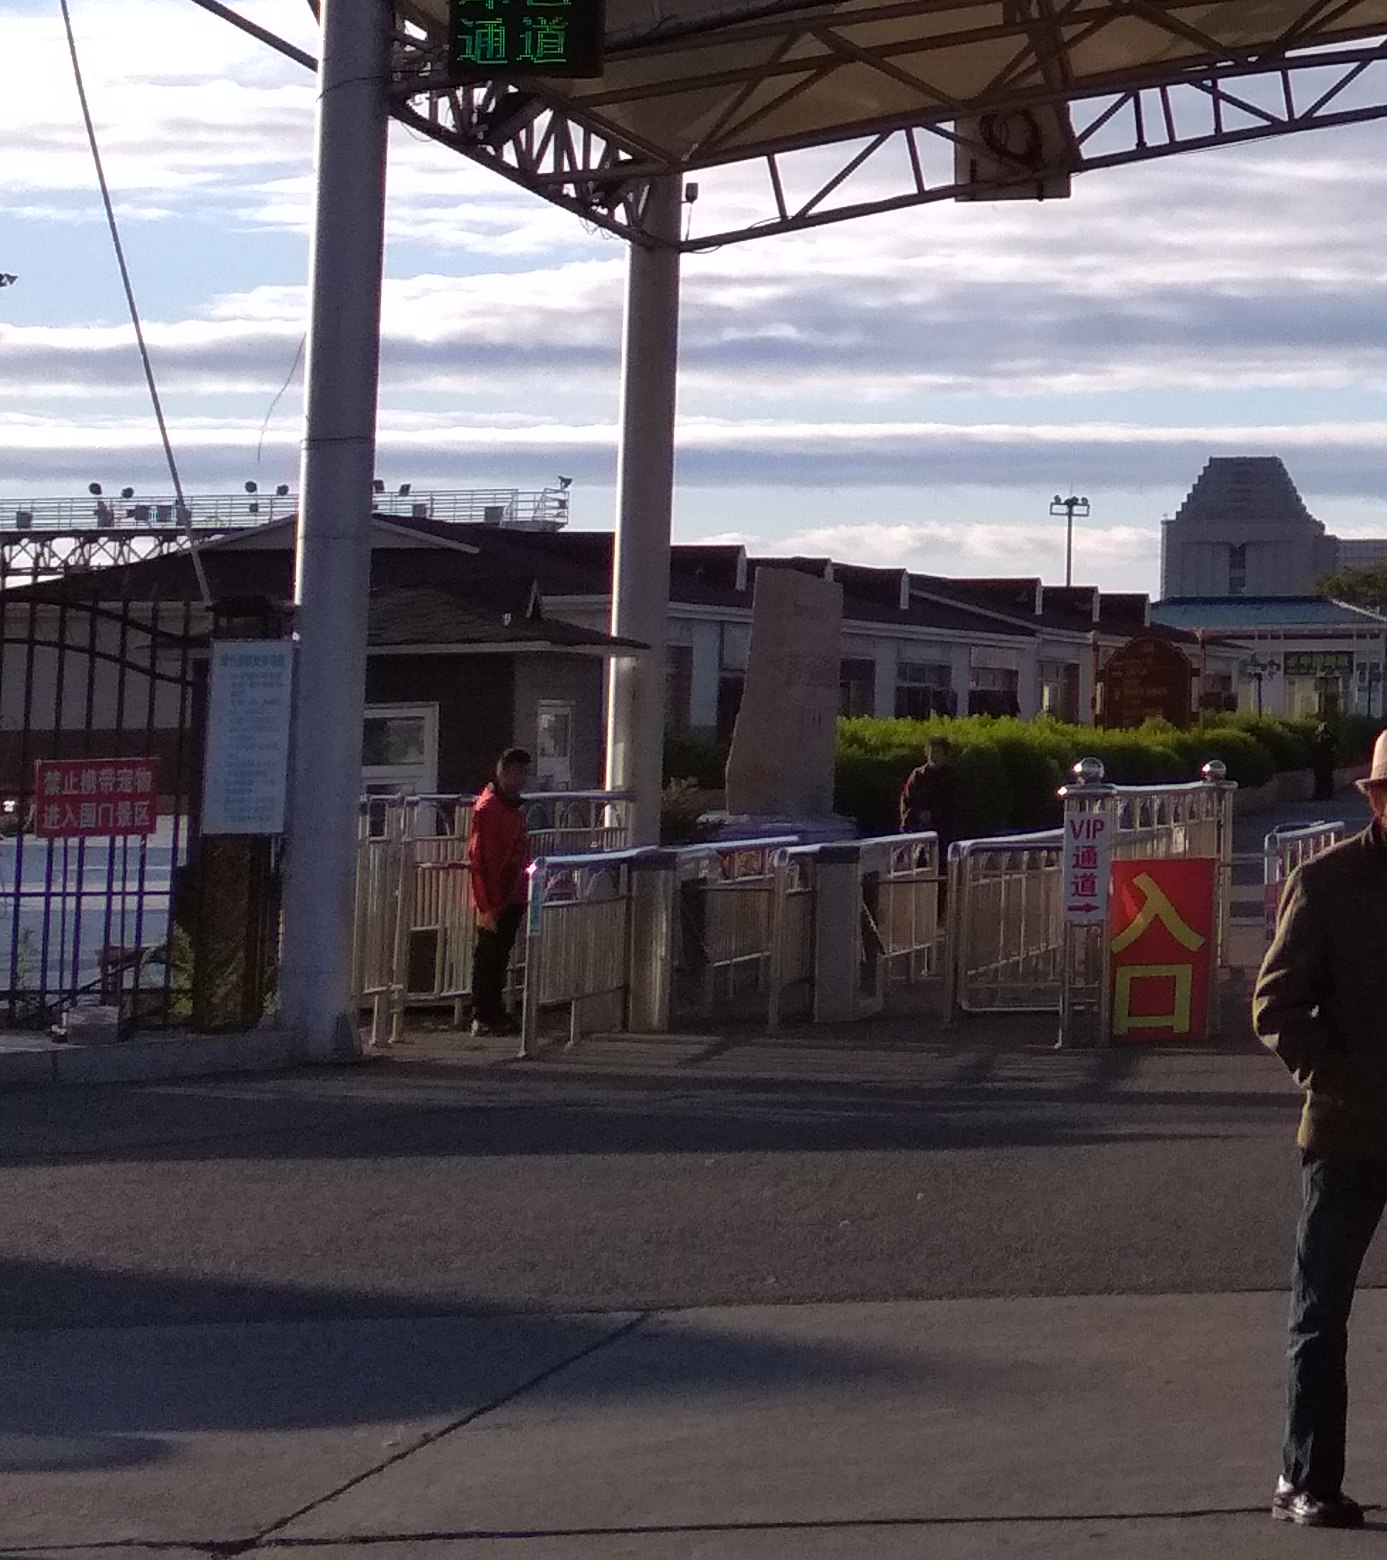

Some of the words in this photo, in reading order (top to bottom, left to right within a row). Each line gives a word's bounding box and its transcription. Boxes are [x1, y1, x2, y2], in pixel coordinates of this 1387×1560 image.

[457, 16, 569, 64] 通道
[42, 800, 151, 829] 进入国门景区
[1070, 819, 1105, 839] VIP
[1070, 844, 1098, 897] 通道
[1111, 871, 1206, 1035] 入口
